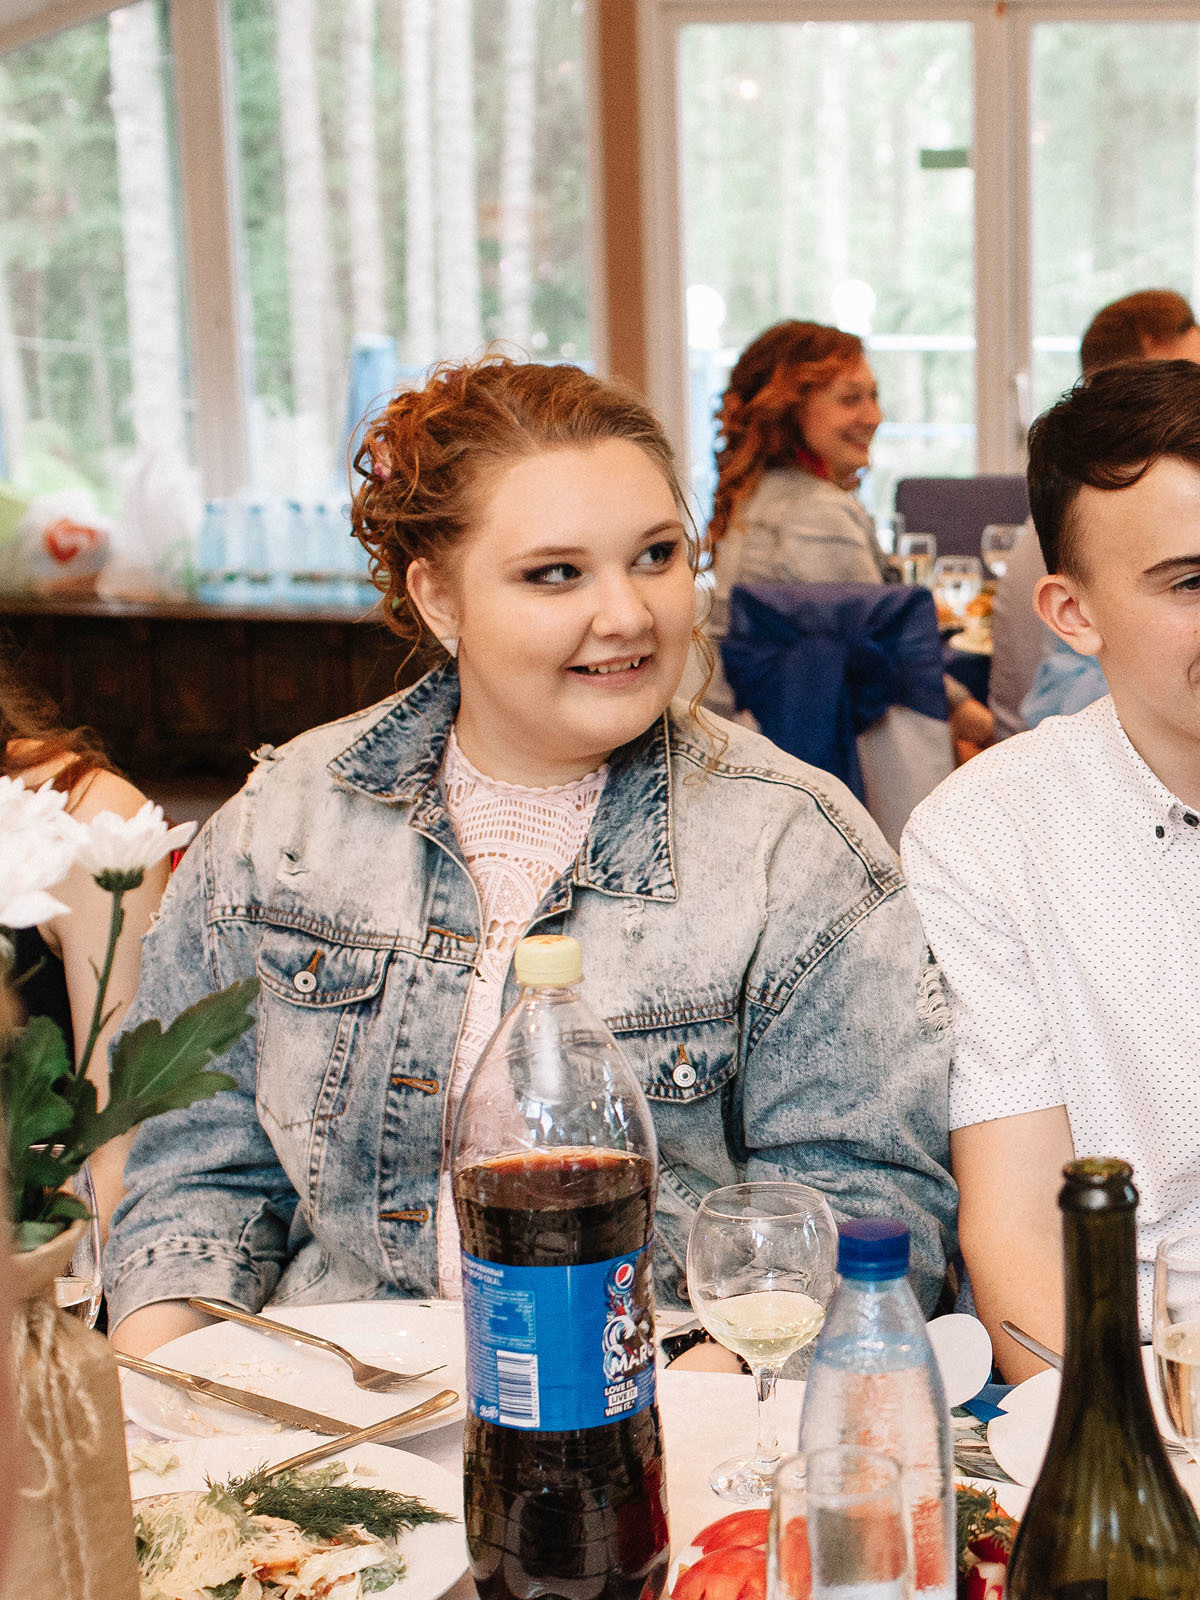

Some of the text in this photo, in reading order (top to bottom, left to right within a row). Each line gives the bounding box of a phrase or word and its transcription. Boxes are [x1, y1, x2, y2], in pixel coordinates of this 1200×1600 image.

[604, 1382, 625, 1396] LOVE
[611, 1391, 627, 1404] LIVE
[605, 1404, 623, 1416] WIN
